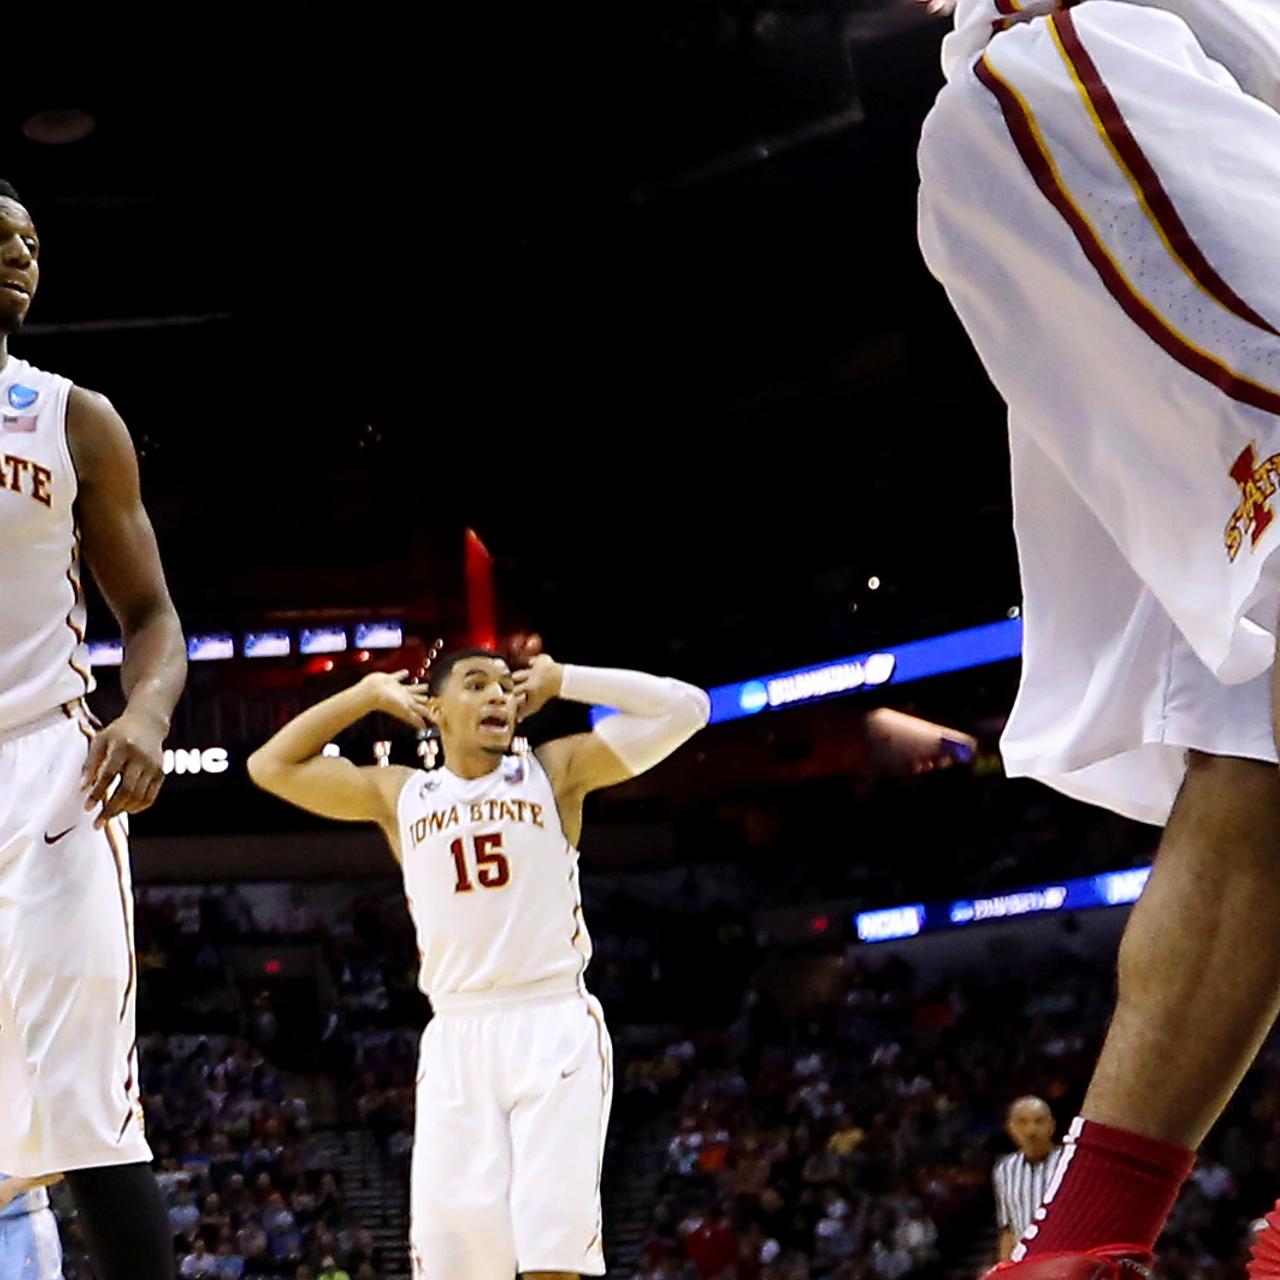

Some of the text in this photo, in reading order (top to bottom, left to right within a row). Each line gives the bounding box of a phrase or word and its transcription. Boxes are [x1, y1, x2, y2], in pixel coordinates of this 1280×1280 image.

[409, 798, 545, 850] IOWA STATE
[449, 831, 512, 894] 15
